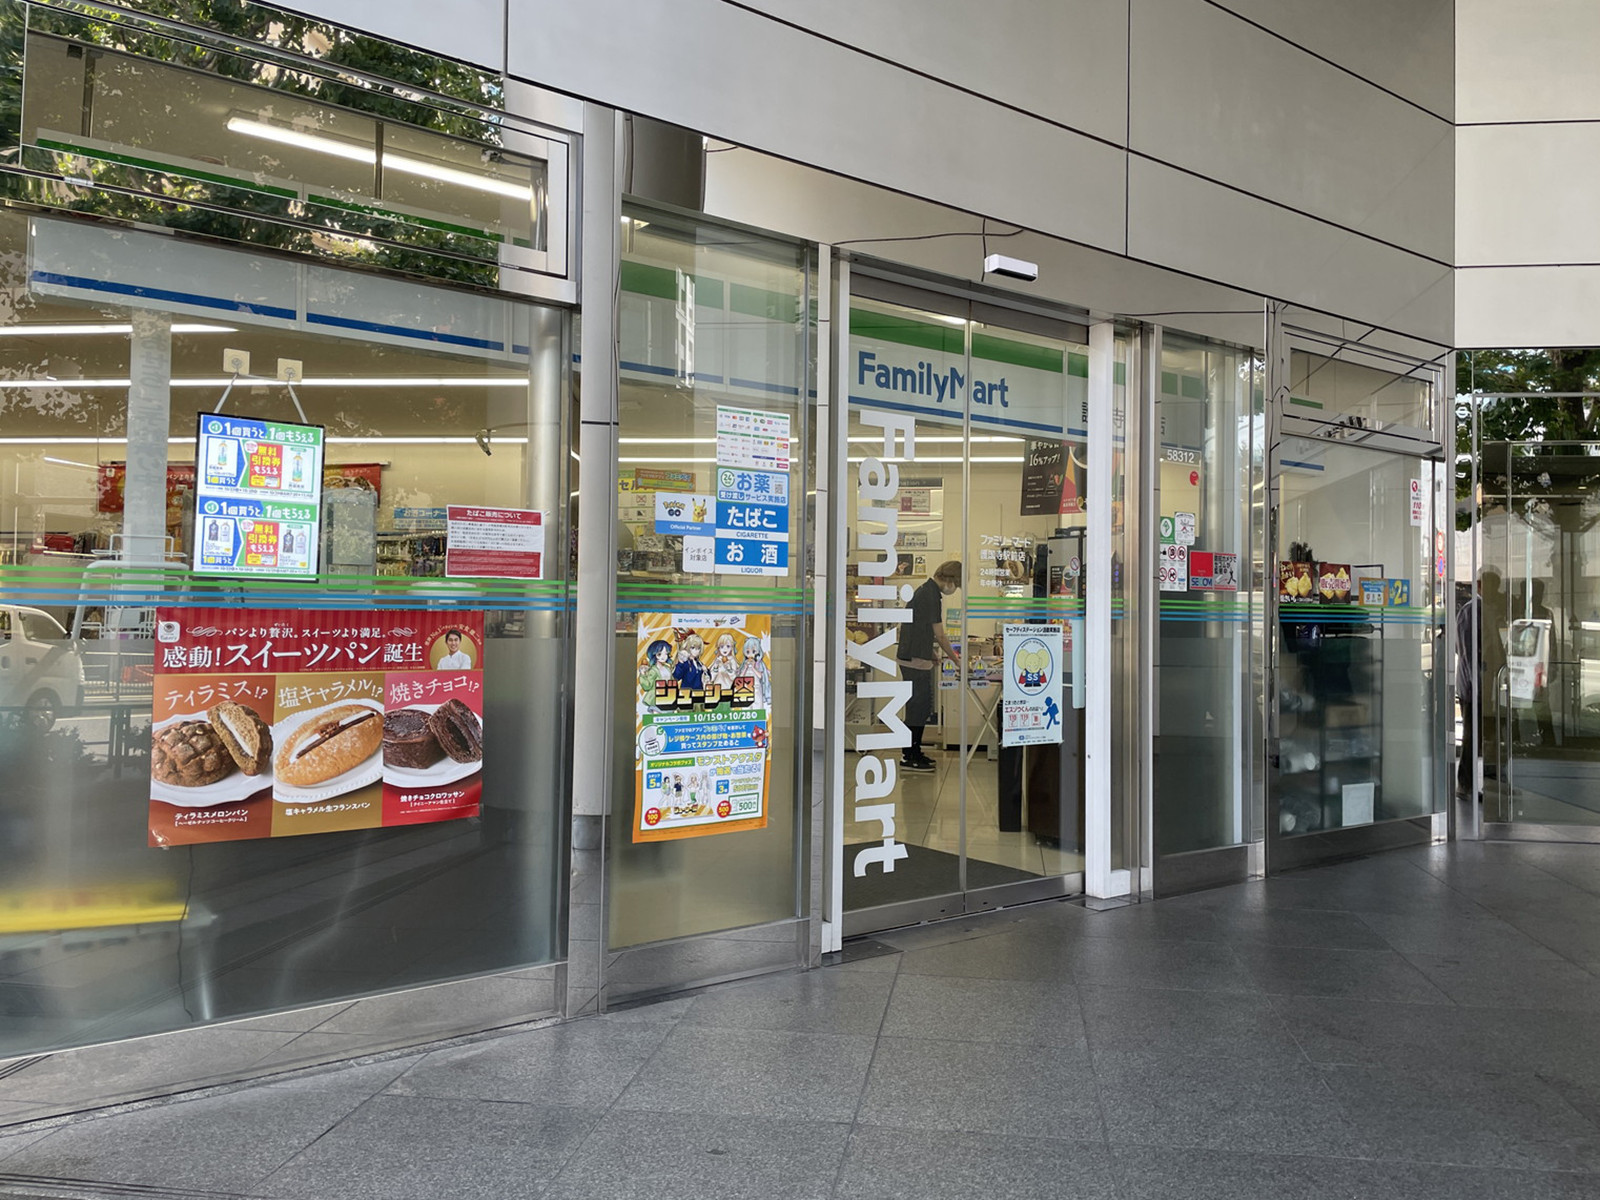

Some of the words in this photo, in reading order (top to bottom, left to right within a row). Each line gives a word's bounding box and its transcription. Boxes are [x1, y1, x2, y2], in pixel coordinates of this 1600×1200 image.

[858, 351, 1009, 408] FamilyMart
[257, 445, 277, 456] 無料
[1166, 449, 1195, 463] 58312
[251, 454, 281, 467] 引換券
[254, 466, 279, 475] もらえる
[207, 476, 236, 486] 1個買うと
[737, 472, 770, 493] お薬
[466, 509, 522, 520] たばこ販売について
[668, 508, 681, 516] GO
[727, 506, 778, 528] たばこ
[253, 524, 274, 534] 無料
[247, 533, 278, 544] 引換券
[736, 531, 769, 539] CIGARETTE
[980, 534, 1031, 548] ファミリーマート
[250, 544, 275, 553] もらえる
[203, 556, 232, 565] 1個買うと
[689, 554, 708, 562] 対象店
[1191, 577, 1213, 587] SECOM
[847, 409, 915, 878] FamilyMart
[1027, 673, 1039, 681] SS
[655, 676, 755, 710] ジューシー祭
[285, 802, 371, 816] 塩キャラメル生フランスパン
[174, 809, 249, 821] ティラミスメロンパン
